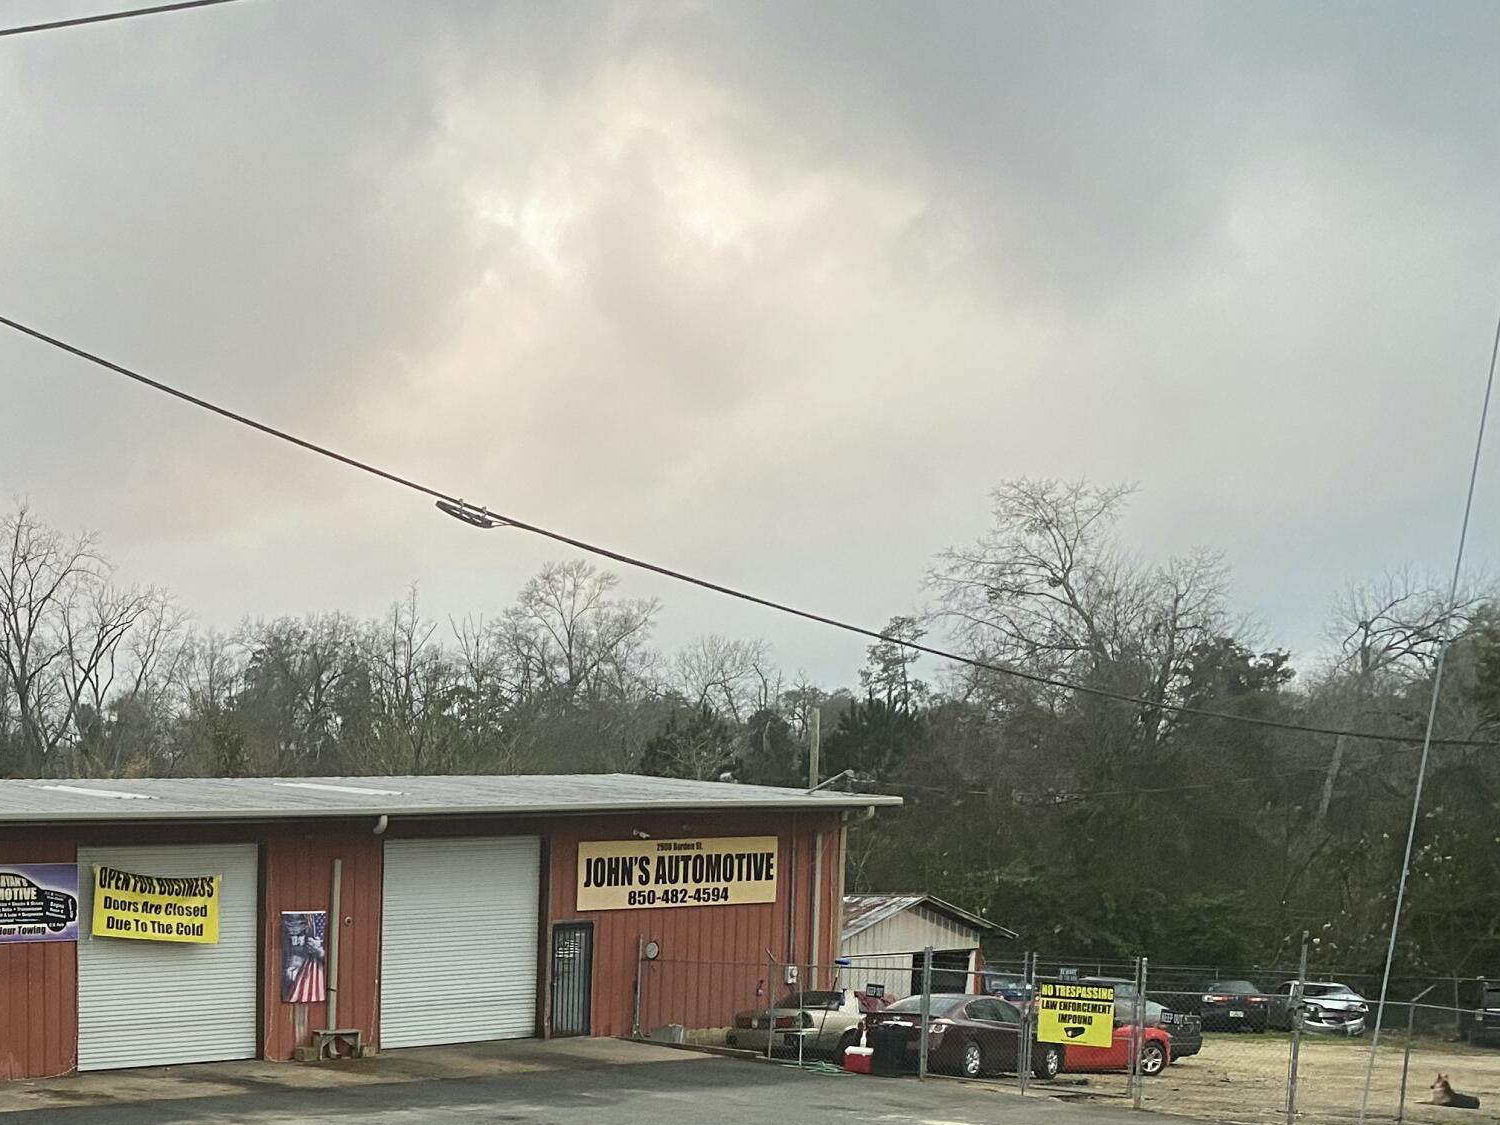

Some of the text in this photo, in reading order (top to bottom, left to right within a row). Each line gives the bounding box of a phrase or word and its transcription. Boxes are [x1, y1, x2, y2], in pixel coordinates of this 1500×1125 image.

[584, 852, 774, 888] JOHN'S AUTOMOTIVE
[99, 866, 214, 898] OPEN FOR BUSINESS
[104, 895, 208, 917] Doors Are Closed
[627, 887, 729, 906] 850-482-4594
[17, 925, 46, 936] Towing
[106, 916, 204, 936] Due To The Cold
[1041, 983, 1115, 1000] NO TRESPASSING
[1041, 999, 1112, 1014] LAW ENFORCEMENT
[1057, 1013, 1093, 1026] IMPOUND
